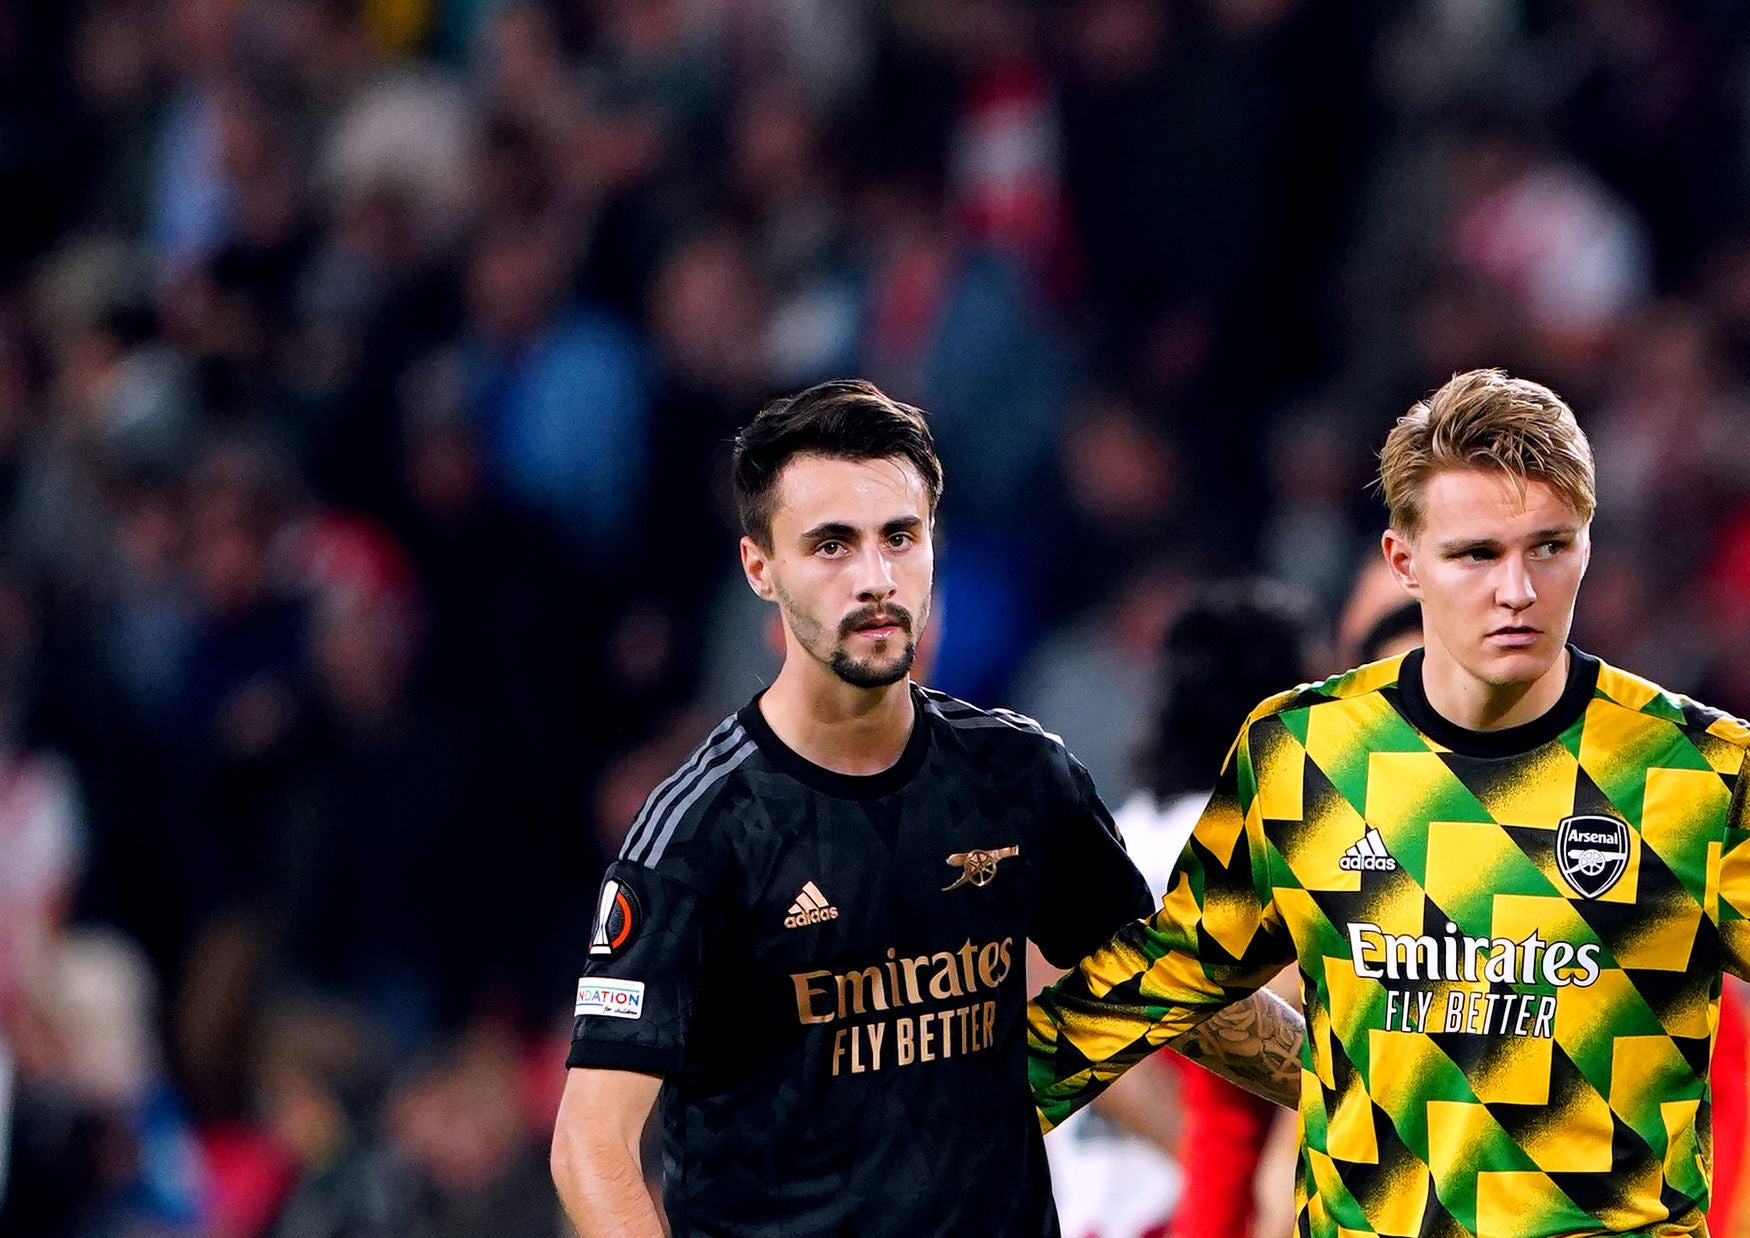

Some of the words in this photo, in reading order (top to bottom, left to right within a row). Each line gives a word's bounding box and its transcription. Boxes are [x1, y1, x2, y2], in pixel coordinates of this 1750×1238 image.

[1568, 829, 1619, 845] Arsenal
[1339, 854, 1396, 871] adidas
[784, 905, 839, 929] adidas
[1346, 922, 1601, 987] Emirates
[789, 937, 1013, 1025] Emirates
[1384, 990, 1434, 1033] FLY
[1445, 991, 1558, 1038] BETTER
[832, 1022, 886, 1077] FLY
[896, 1001, 996, 1067] BETTER
